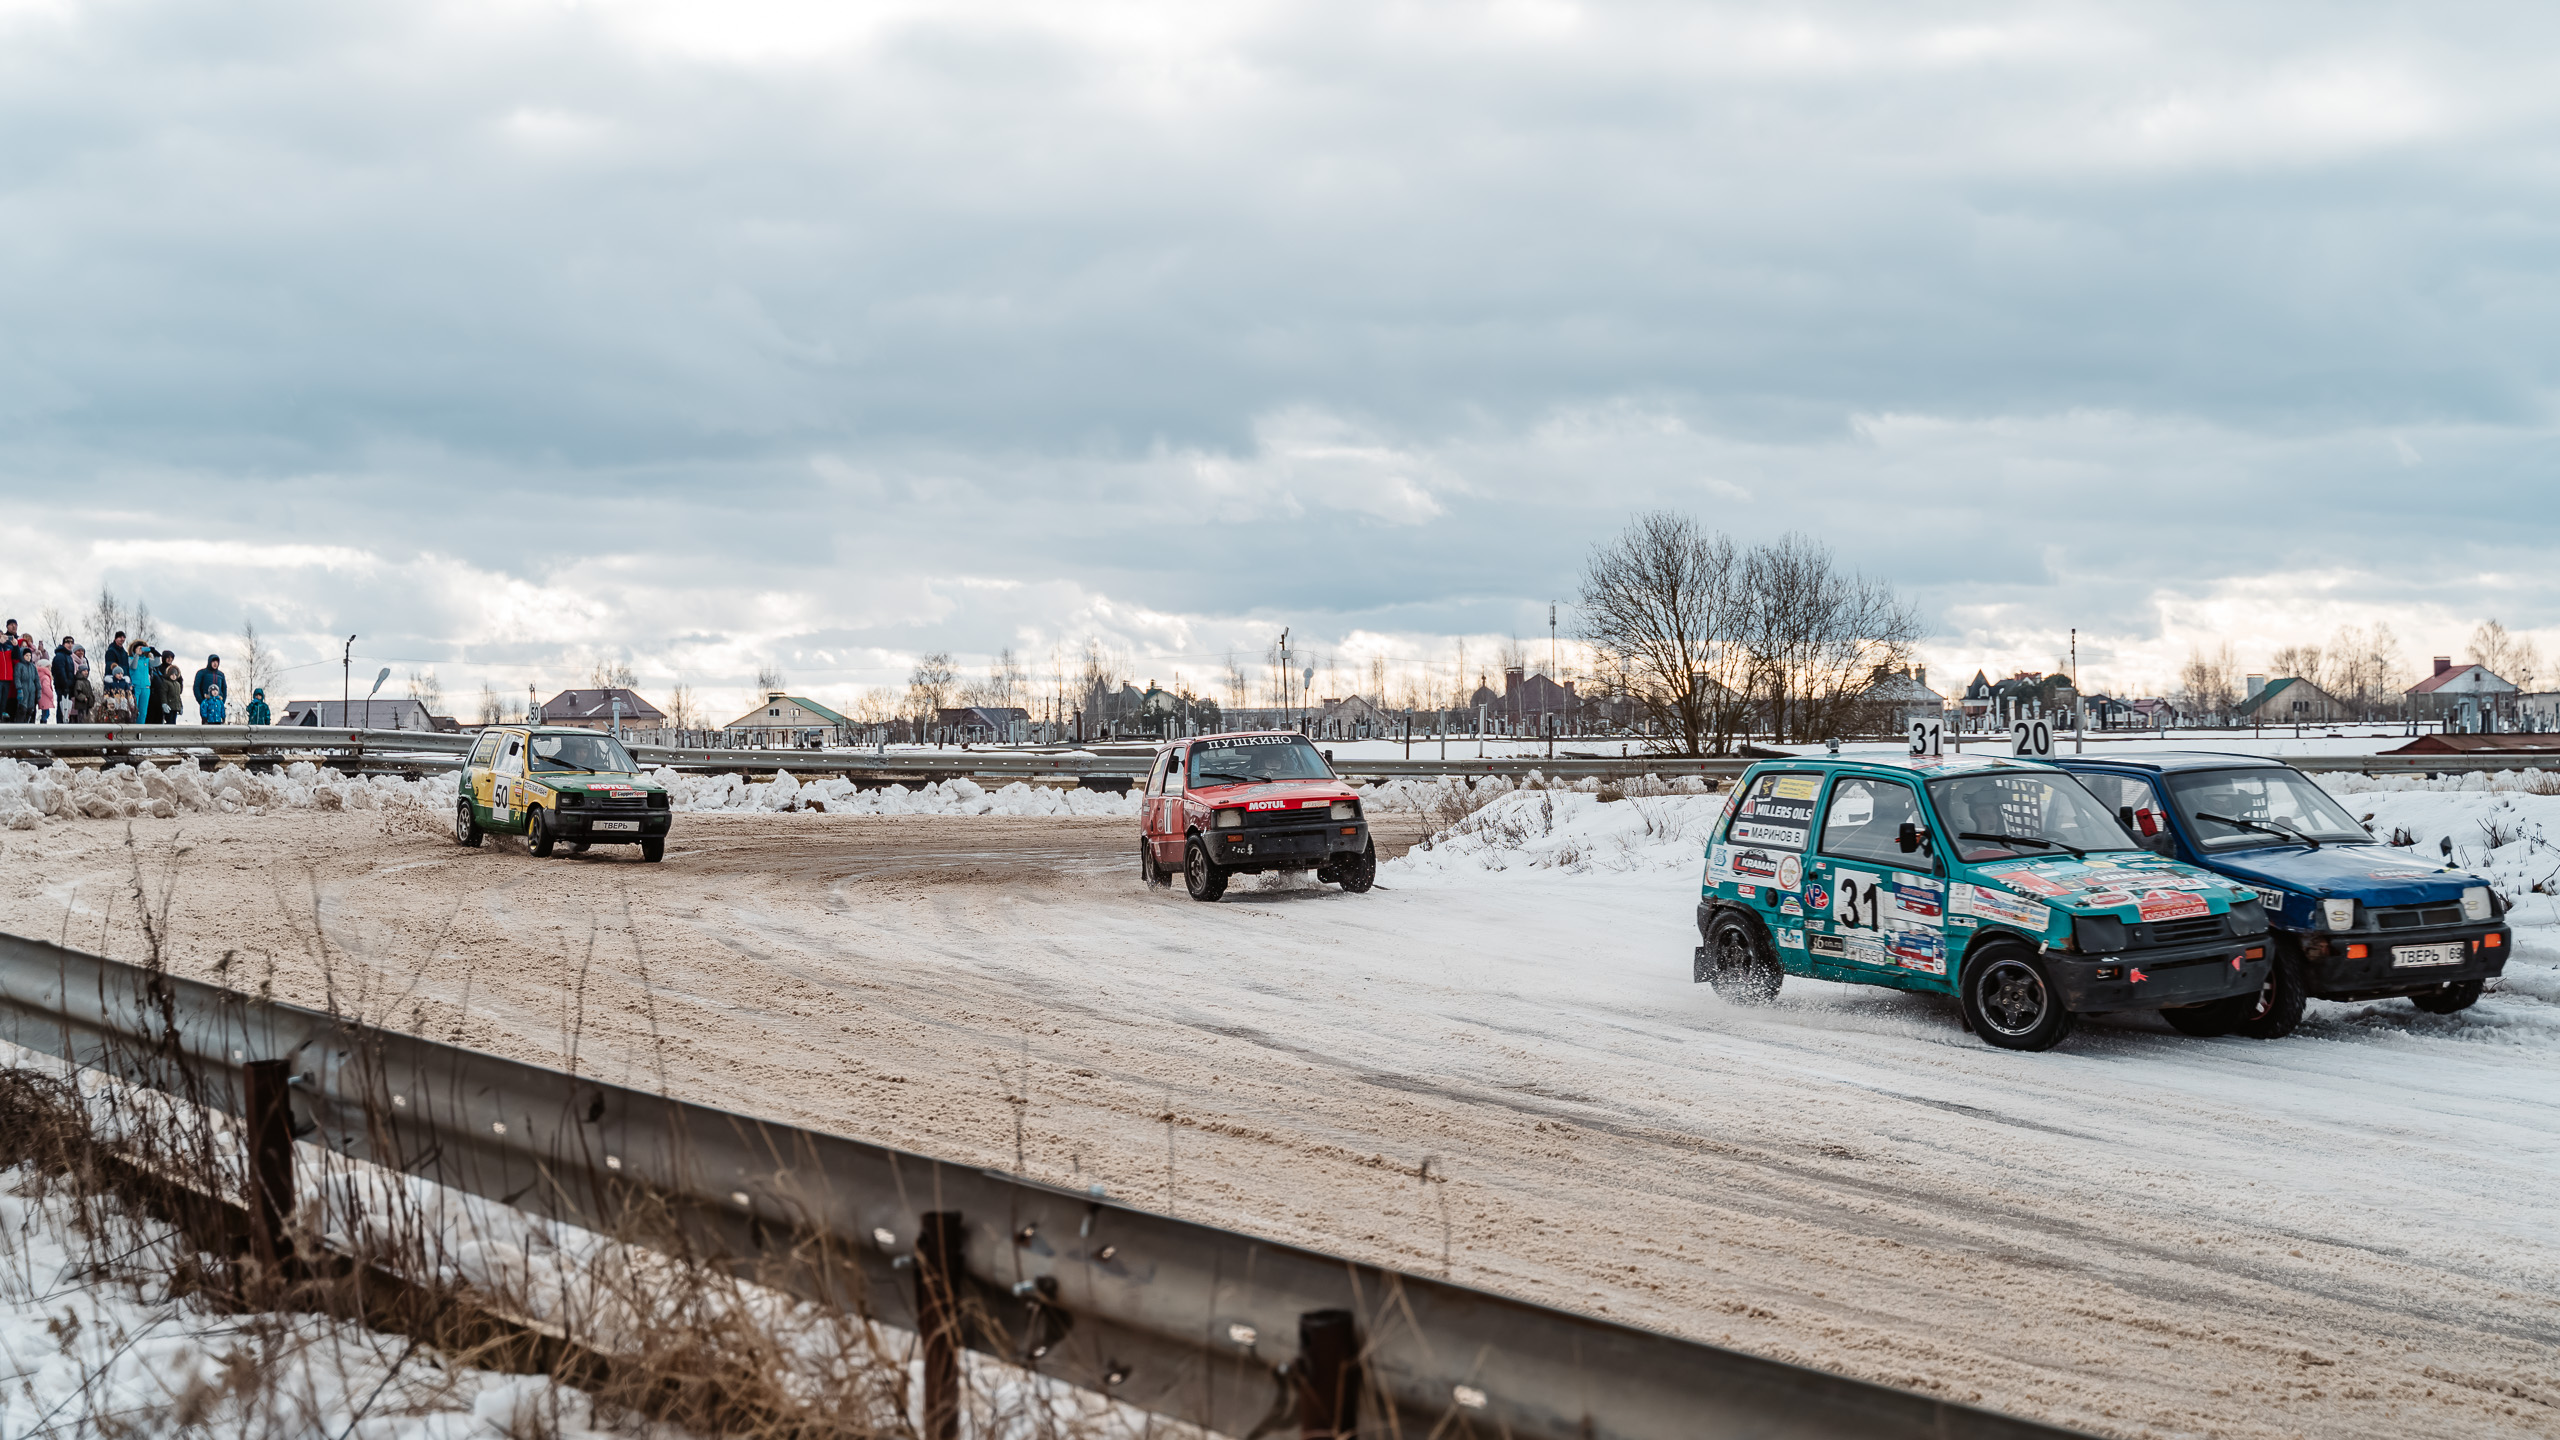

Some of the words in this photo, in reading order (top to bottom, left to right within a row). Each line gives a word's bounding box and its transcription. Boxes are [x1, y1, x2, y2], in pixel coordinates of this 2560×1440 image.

[531, 706, 539, 721] 50
[1206, 735, 1292, 750] ПУШКИНО
[1912, 722, 1940, 755] 31
[2014, 721, 2050, 756] 20
[495, 784, 508, 809] 50
[1248, 800, 1286, 811] MOTUL
[1755, 803, 1792, 820] MILLERS
[1792, 807, 1813, 821] OILS
[603, 822, 628, 830] ТВЕРЬ
[1751, 826, 1792, 843] МАРИНОВ
[1741, 857, 1777, 872] KRAMAR
[1840, 878, 1878, 932] 31
[2400, 948, 2440, 964] ТВЕРЬ
[2449, 946, 2464, 960] 69
